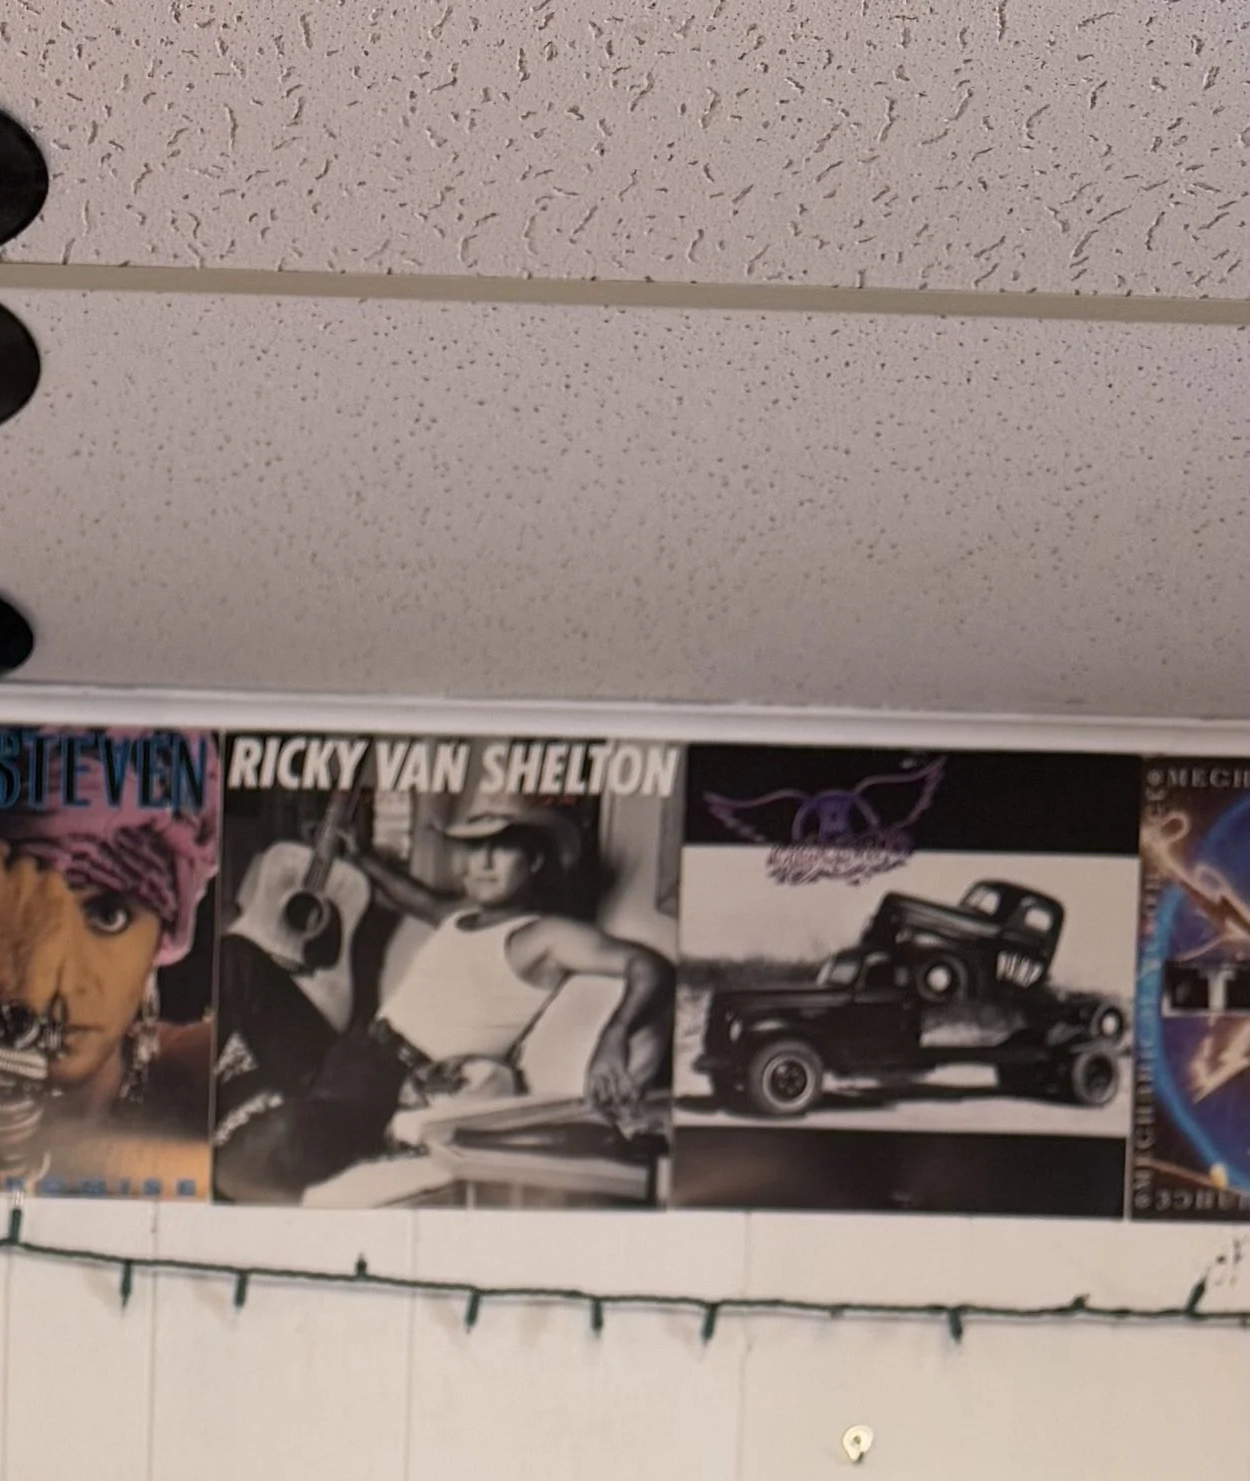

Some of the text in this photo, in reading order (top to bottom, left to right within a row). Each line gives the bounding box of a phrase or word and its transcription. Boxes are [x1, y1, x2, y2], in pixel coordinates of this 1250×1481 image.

[226, 737, 679, 797] RICKY VAN SHELTON
